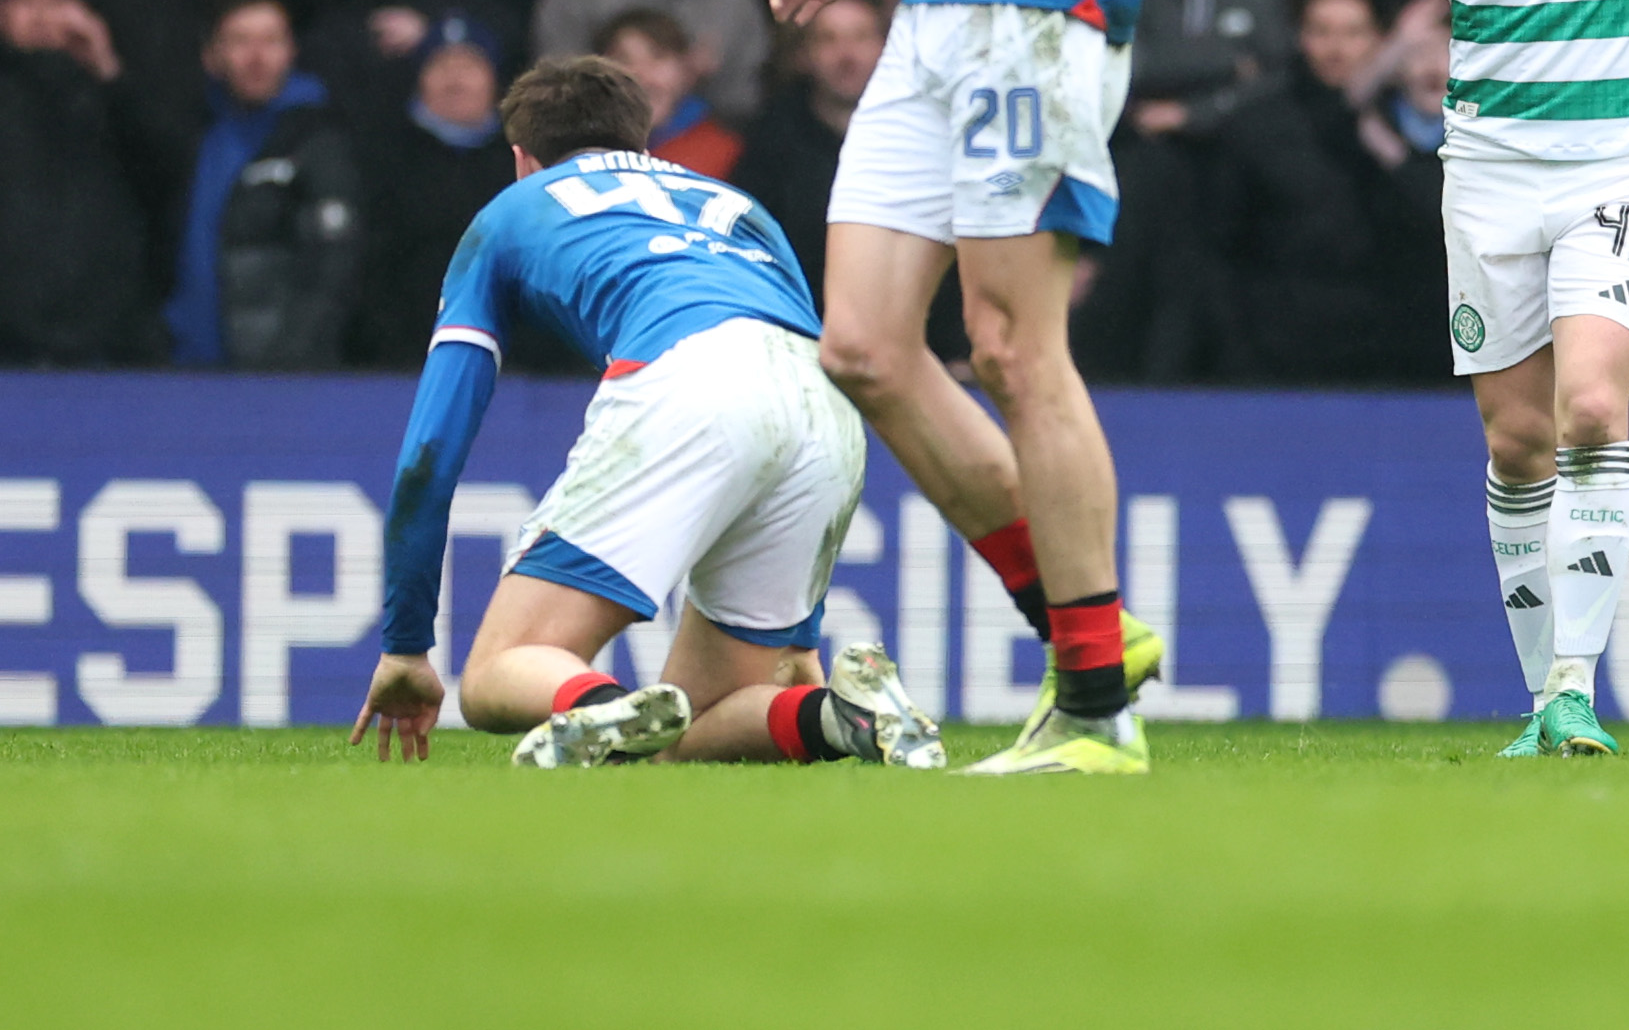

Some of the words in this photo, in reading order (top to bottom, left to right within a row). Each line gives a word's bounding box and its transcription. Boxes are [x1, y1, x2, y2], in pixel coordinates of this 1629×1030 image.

[964, 87, 1042, 159] 20
[544, 171, 753, 237] 47
[1570, 508, 1625, 523] CELTIC
[1492, 540, 1541, 556] CELTIC
